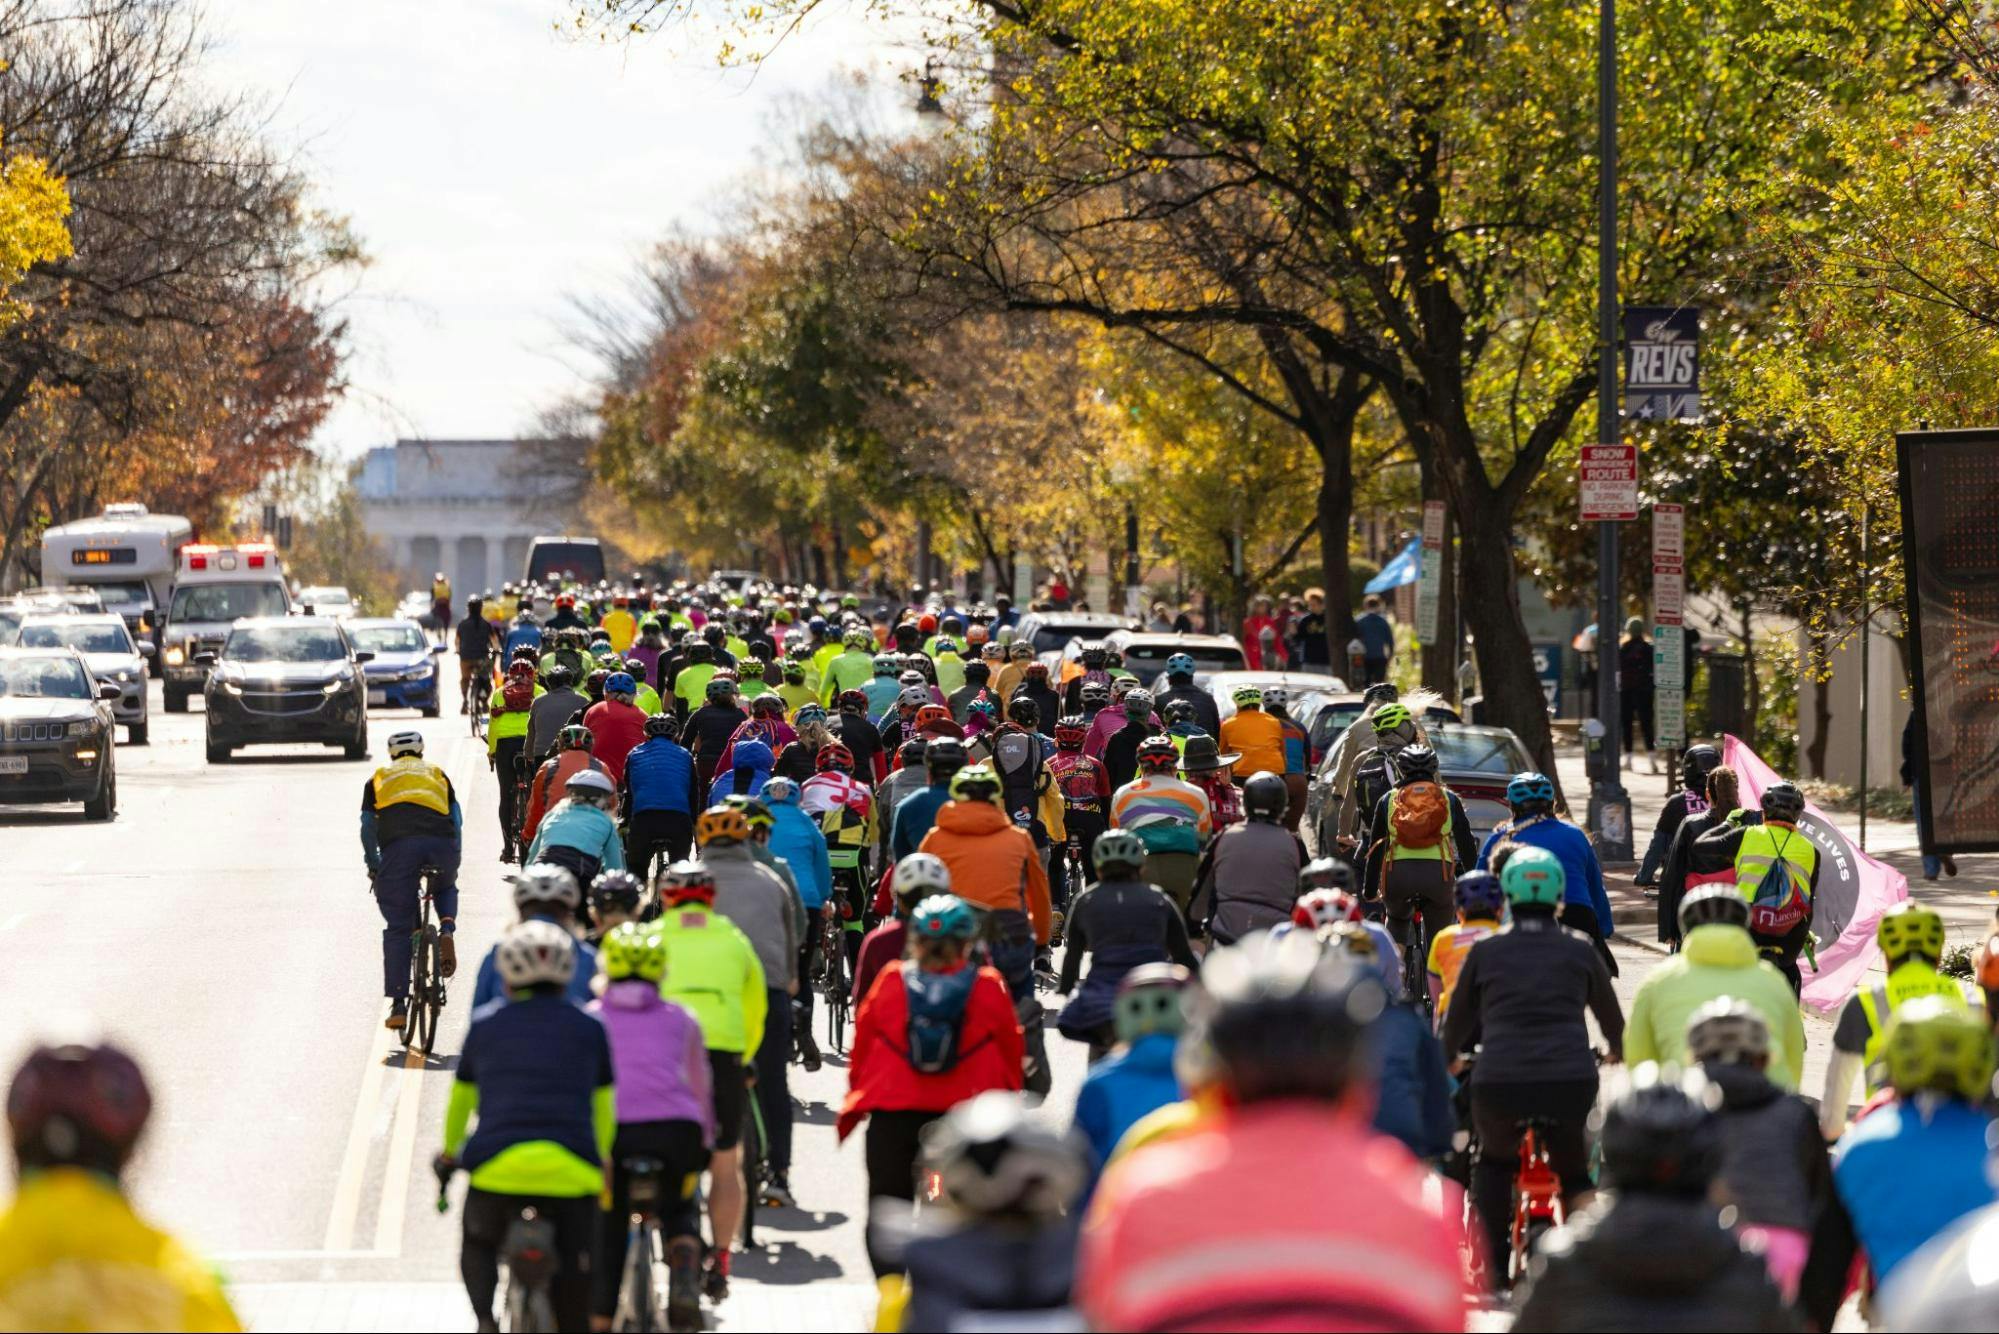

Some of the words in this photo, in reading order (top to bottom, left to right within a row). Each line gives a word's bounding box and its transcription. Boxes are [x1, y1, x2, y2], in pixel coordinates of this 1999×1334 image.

[1630, 346, 1696, 384] REVS
[1590, 448, 1627, 459] SNOW
[1583, 460, 1633, 468] EMERGENCY
[1587, 469, 1630, 480] ROUTE
[1583, 482, 1596, 491] NO
[1817, 832, 1850, 881] LIVES
[1775, 908, 1801, 922] Lincoln
